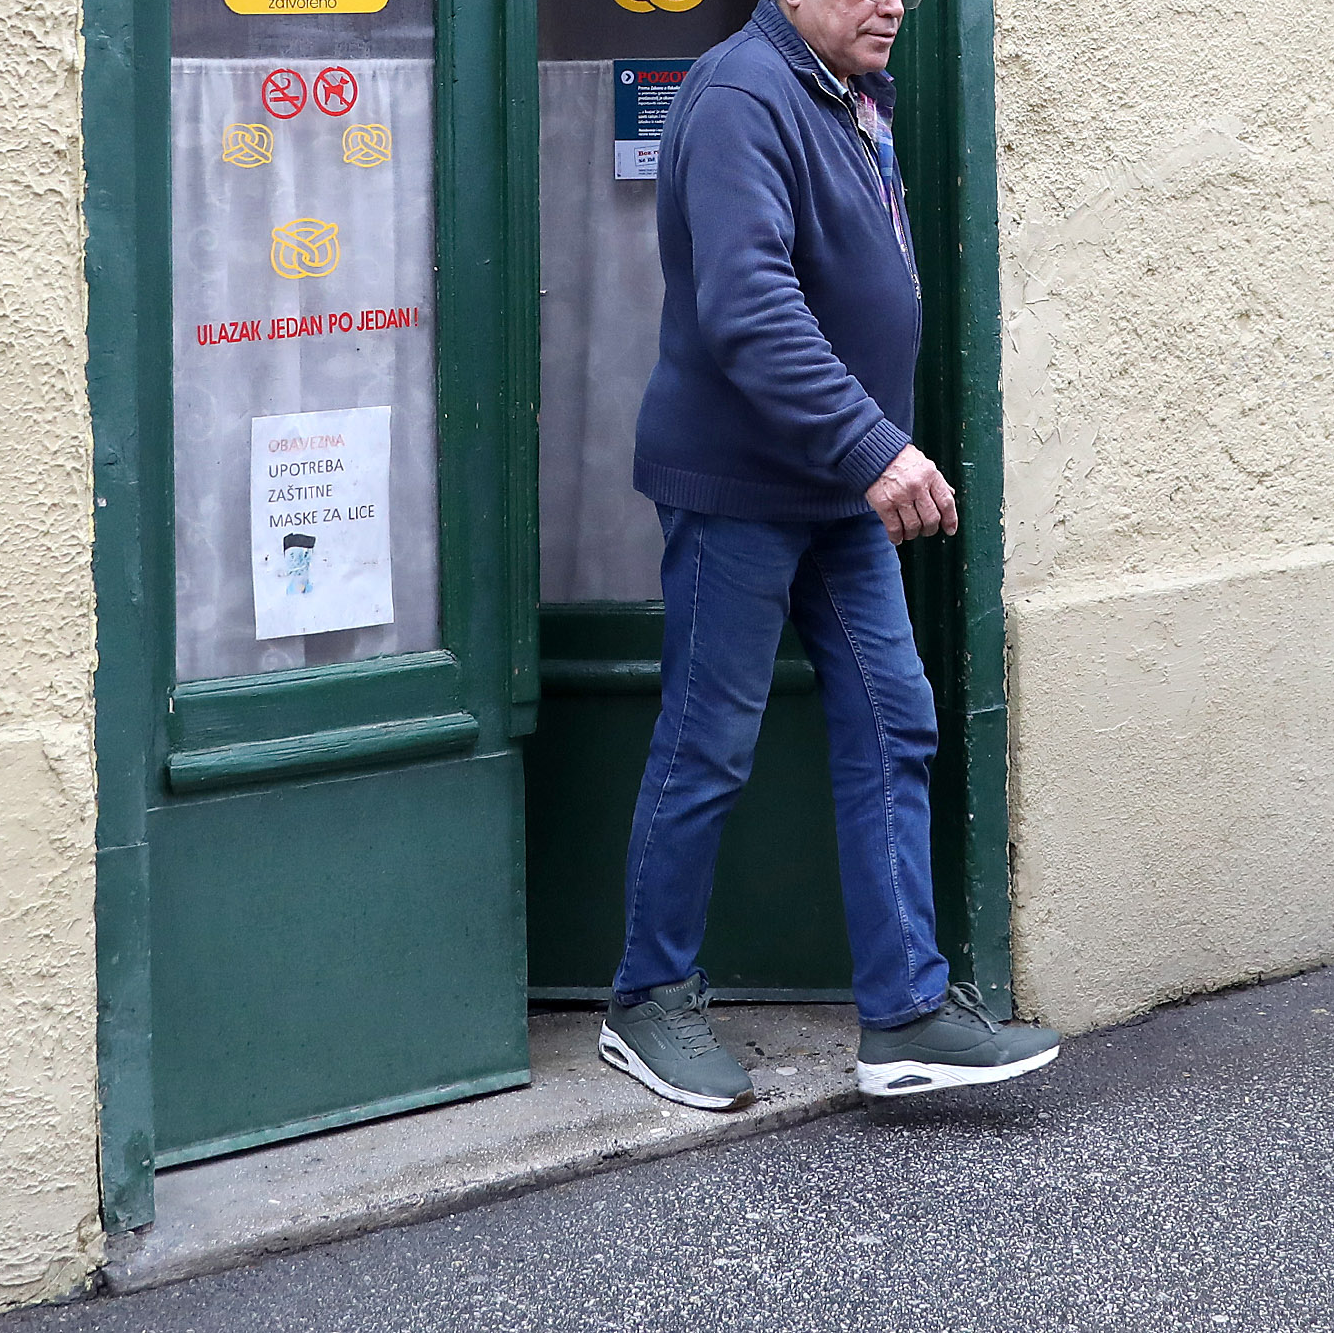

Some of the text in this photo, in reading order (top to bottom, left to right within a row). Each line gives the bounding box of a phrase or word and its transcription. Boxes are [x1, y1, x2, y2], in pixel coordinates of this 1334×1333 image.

[196, 319, 262, 346] ULAZAK
[267, 314, 323, 340] JEDAN
[328, 311, 353, 333] PO
[267, 433, 345, 453] OBAVEZNA
[268, 458, 344, 477] UPOTREBA
[267, 483, 333, 503] ZAŠTITNE
[268, 504, 375, 528] MASKE ZA LICE
